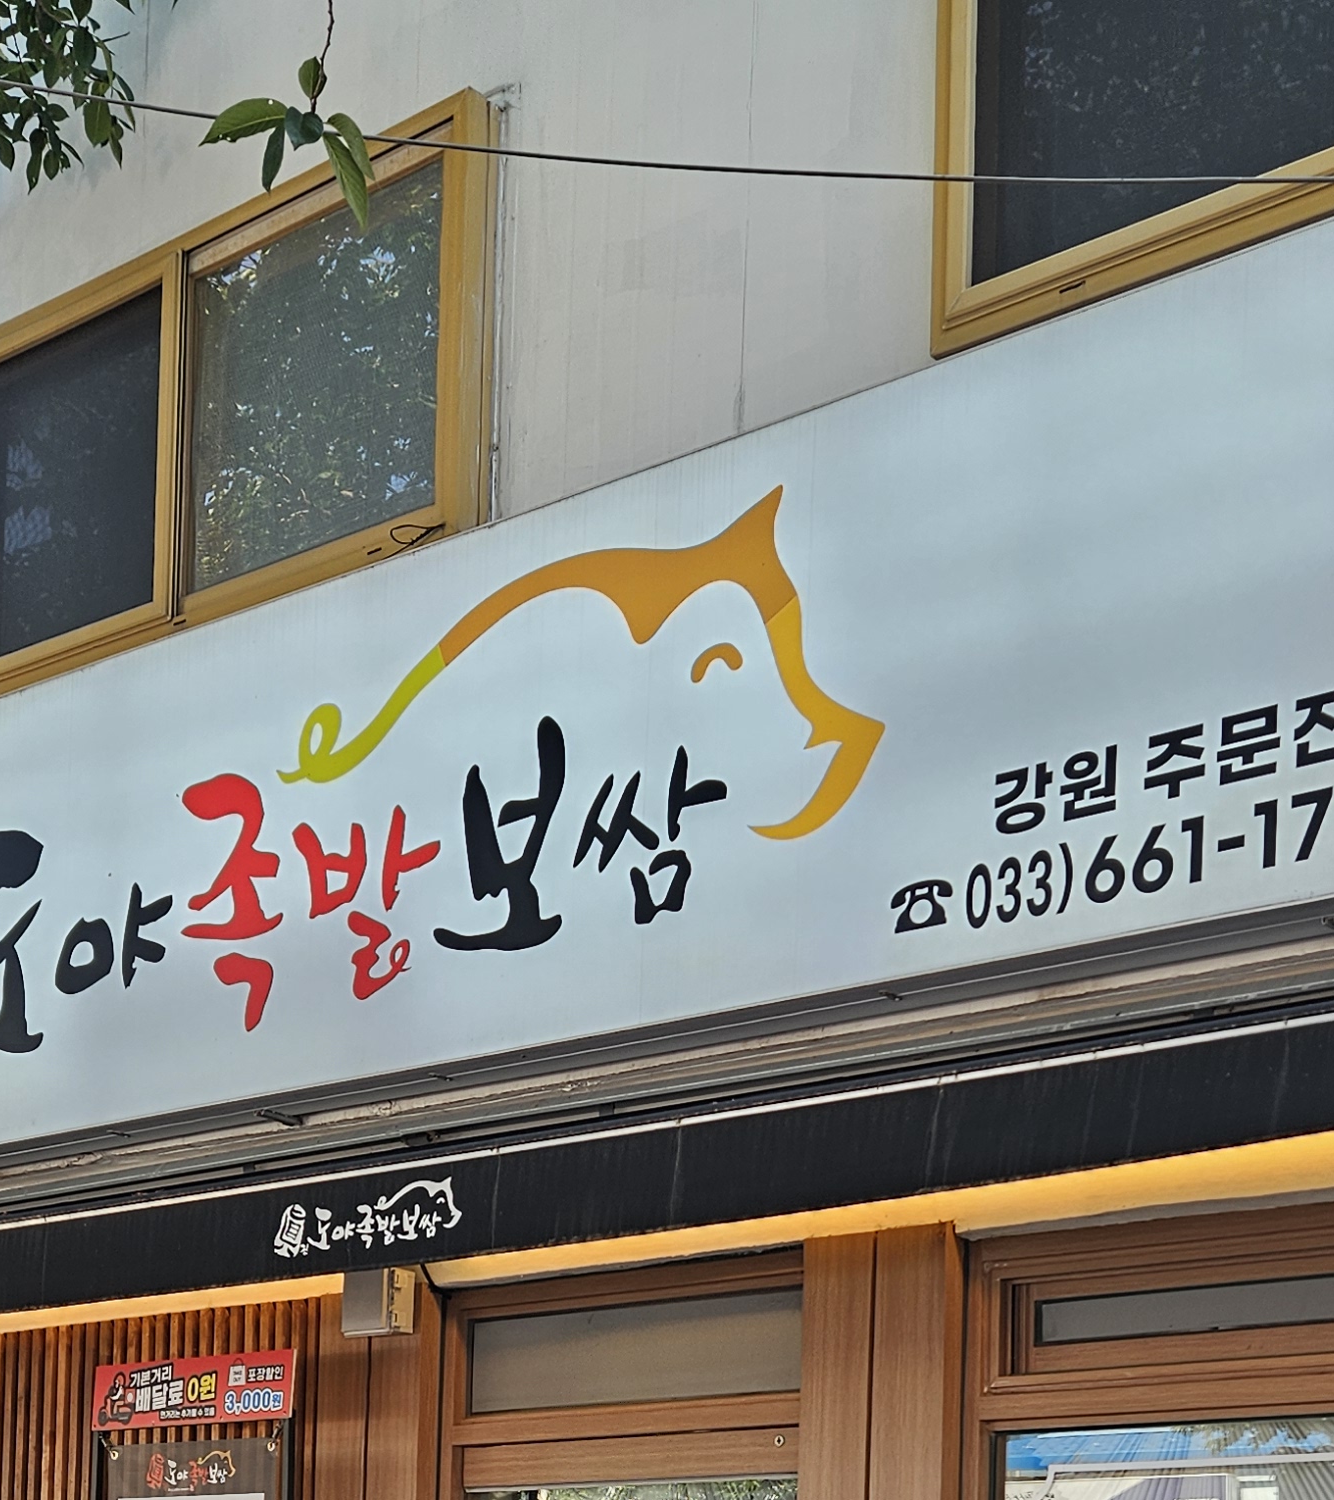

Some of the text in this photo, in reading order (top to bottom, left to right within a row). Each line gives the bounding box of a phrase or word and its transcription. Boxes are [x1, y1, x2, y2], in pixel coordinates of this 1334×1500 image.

[994, 744, 1118, 834] 강원
[129, 1364, 173, 1388] 기본거리
[246, 1365, 284, 1383] 포장할인
[135, 1380, 184, 1412] 배달료
[186, 1373, 216, 1403] 0원
[224, 1388, 284, 1416] 3,000원
